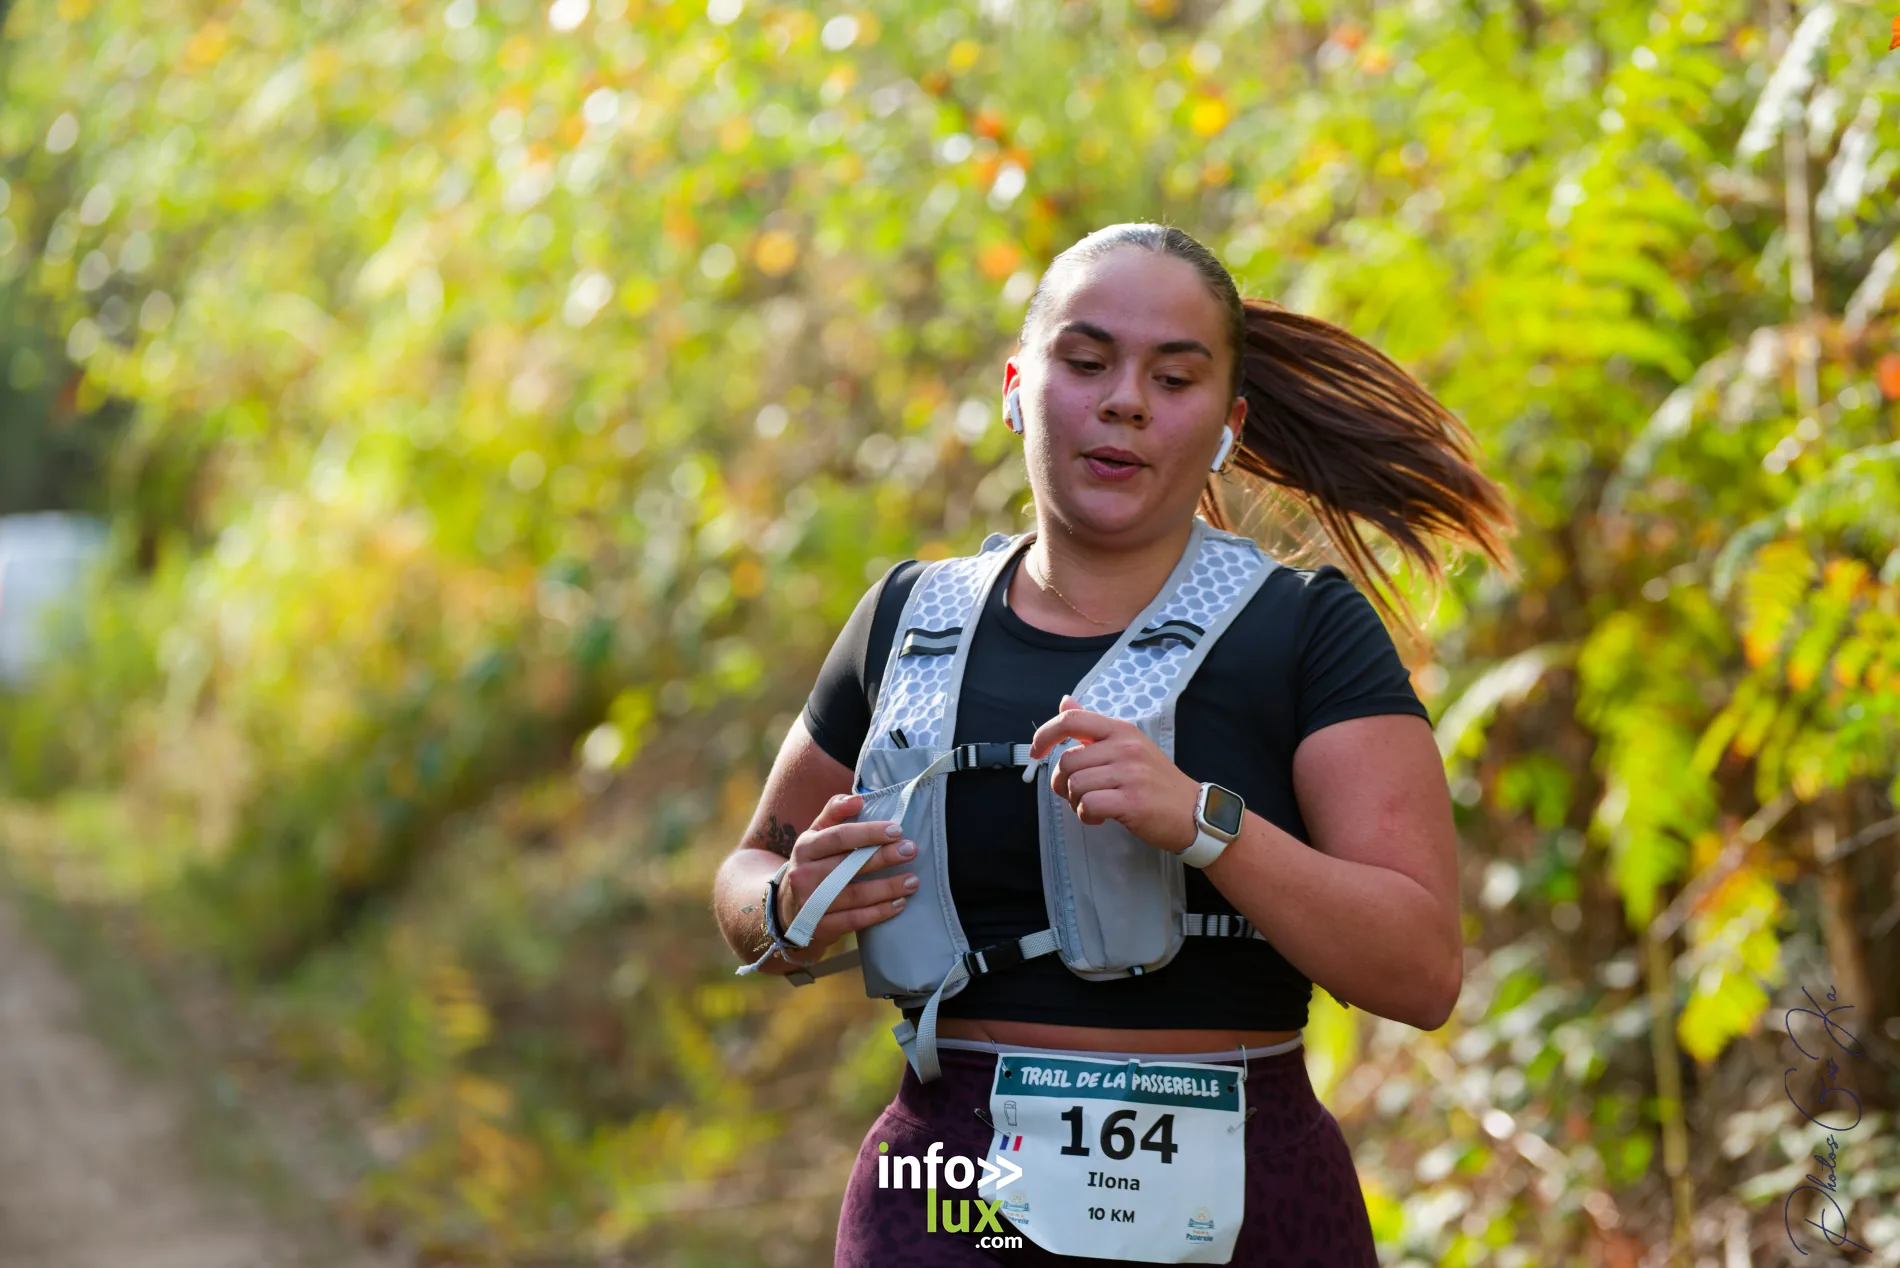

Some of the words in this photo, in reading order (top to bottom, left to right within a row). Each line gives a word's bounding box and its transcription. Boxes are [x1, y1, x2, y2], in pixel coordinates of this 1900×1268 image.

[1021, 1066, 1072, 1088] TRAIL
[1076, 1071, 1102, 1089] DE
[1102, 1072, 1126, 1089] LA
[1131, 1073, 1220, 1098] PASSERELLE
[1060, 1106, 1178, 1165] 164
[1087, 1171, 1141, 1192] Ilona
[1087, 1206, 1106, 1222] 10
[1110, 1208, 1136, 1224] KM
